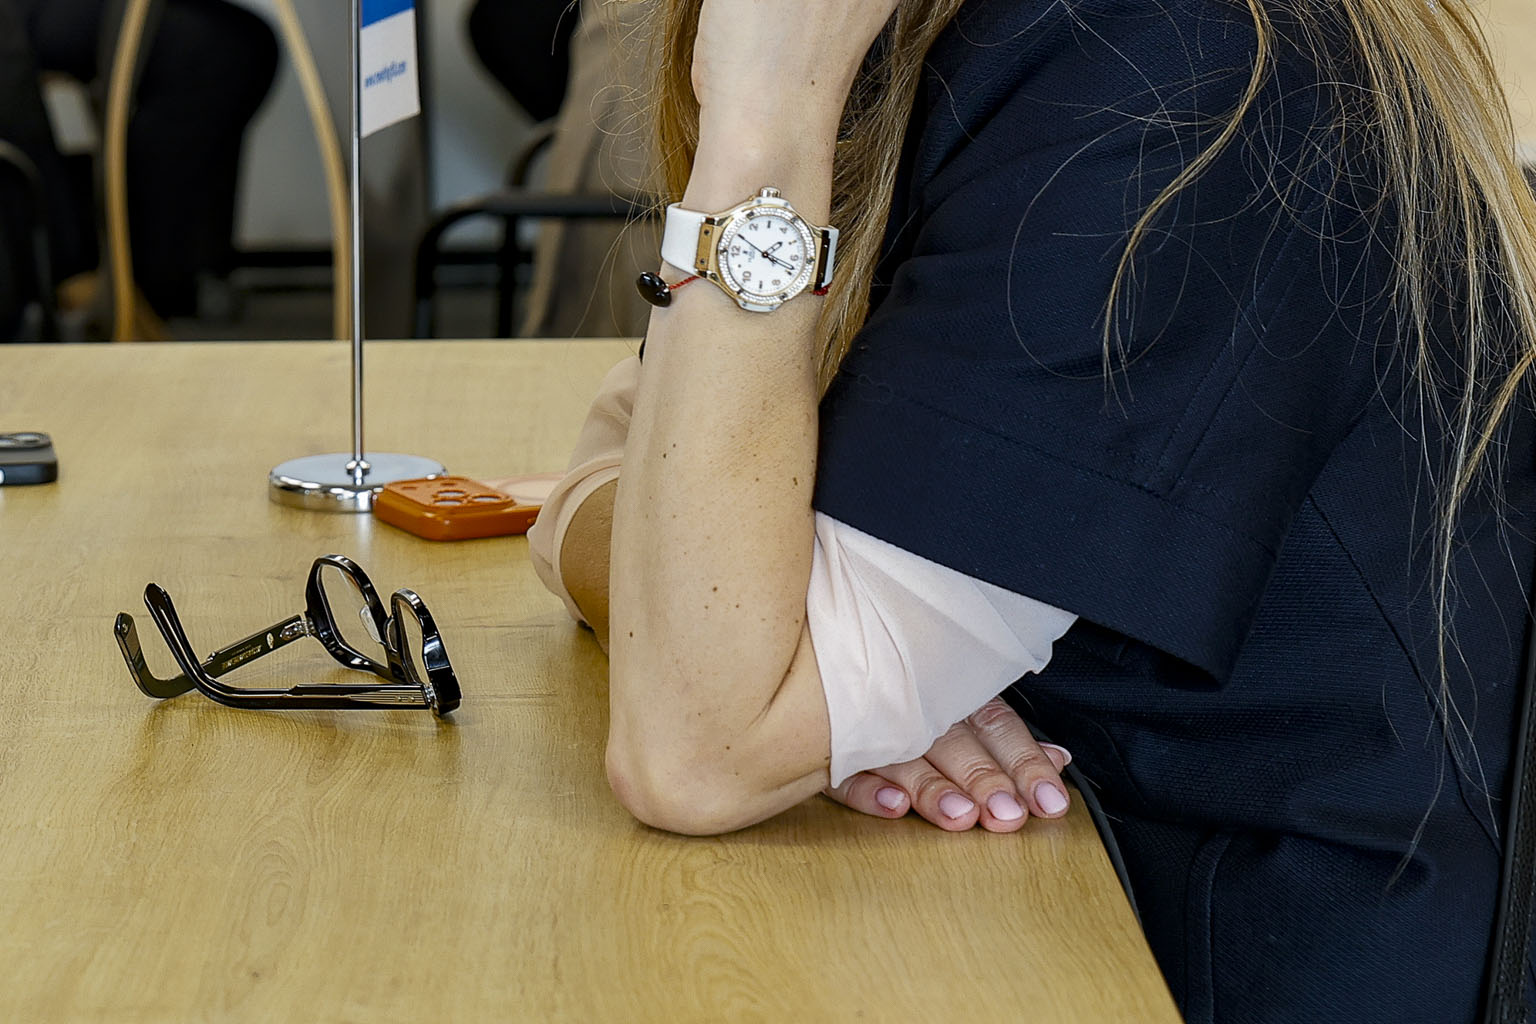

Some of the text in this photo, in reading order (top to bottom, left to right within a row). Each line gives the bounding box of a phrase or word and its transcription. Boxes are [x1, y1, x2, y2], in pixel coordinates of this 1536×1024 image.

[749, 223, 758, 231] 2
[779, 226, 788, 234] 4
[731, 245, 741, 258] 12
[790, 254, 799, 262] 6
[742, 270, 752, 283] 10
